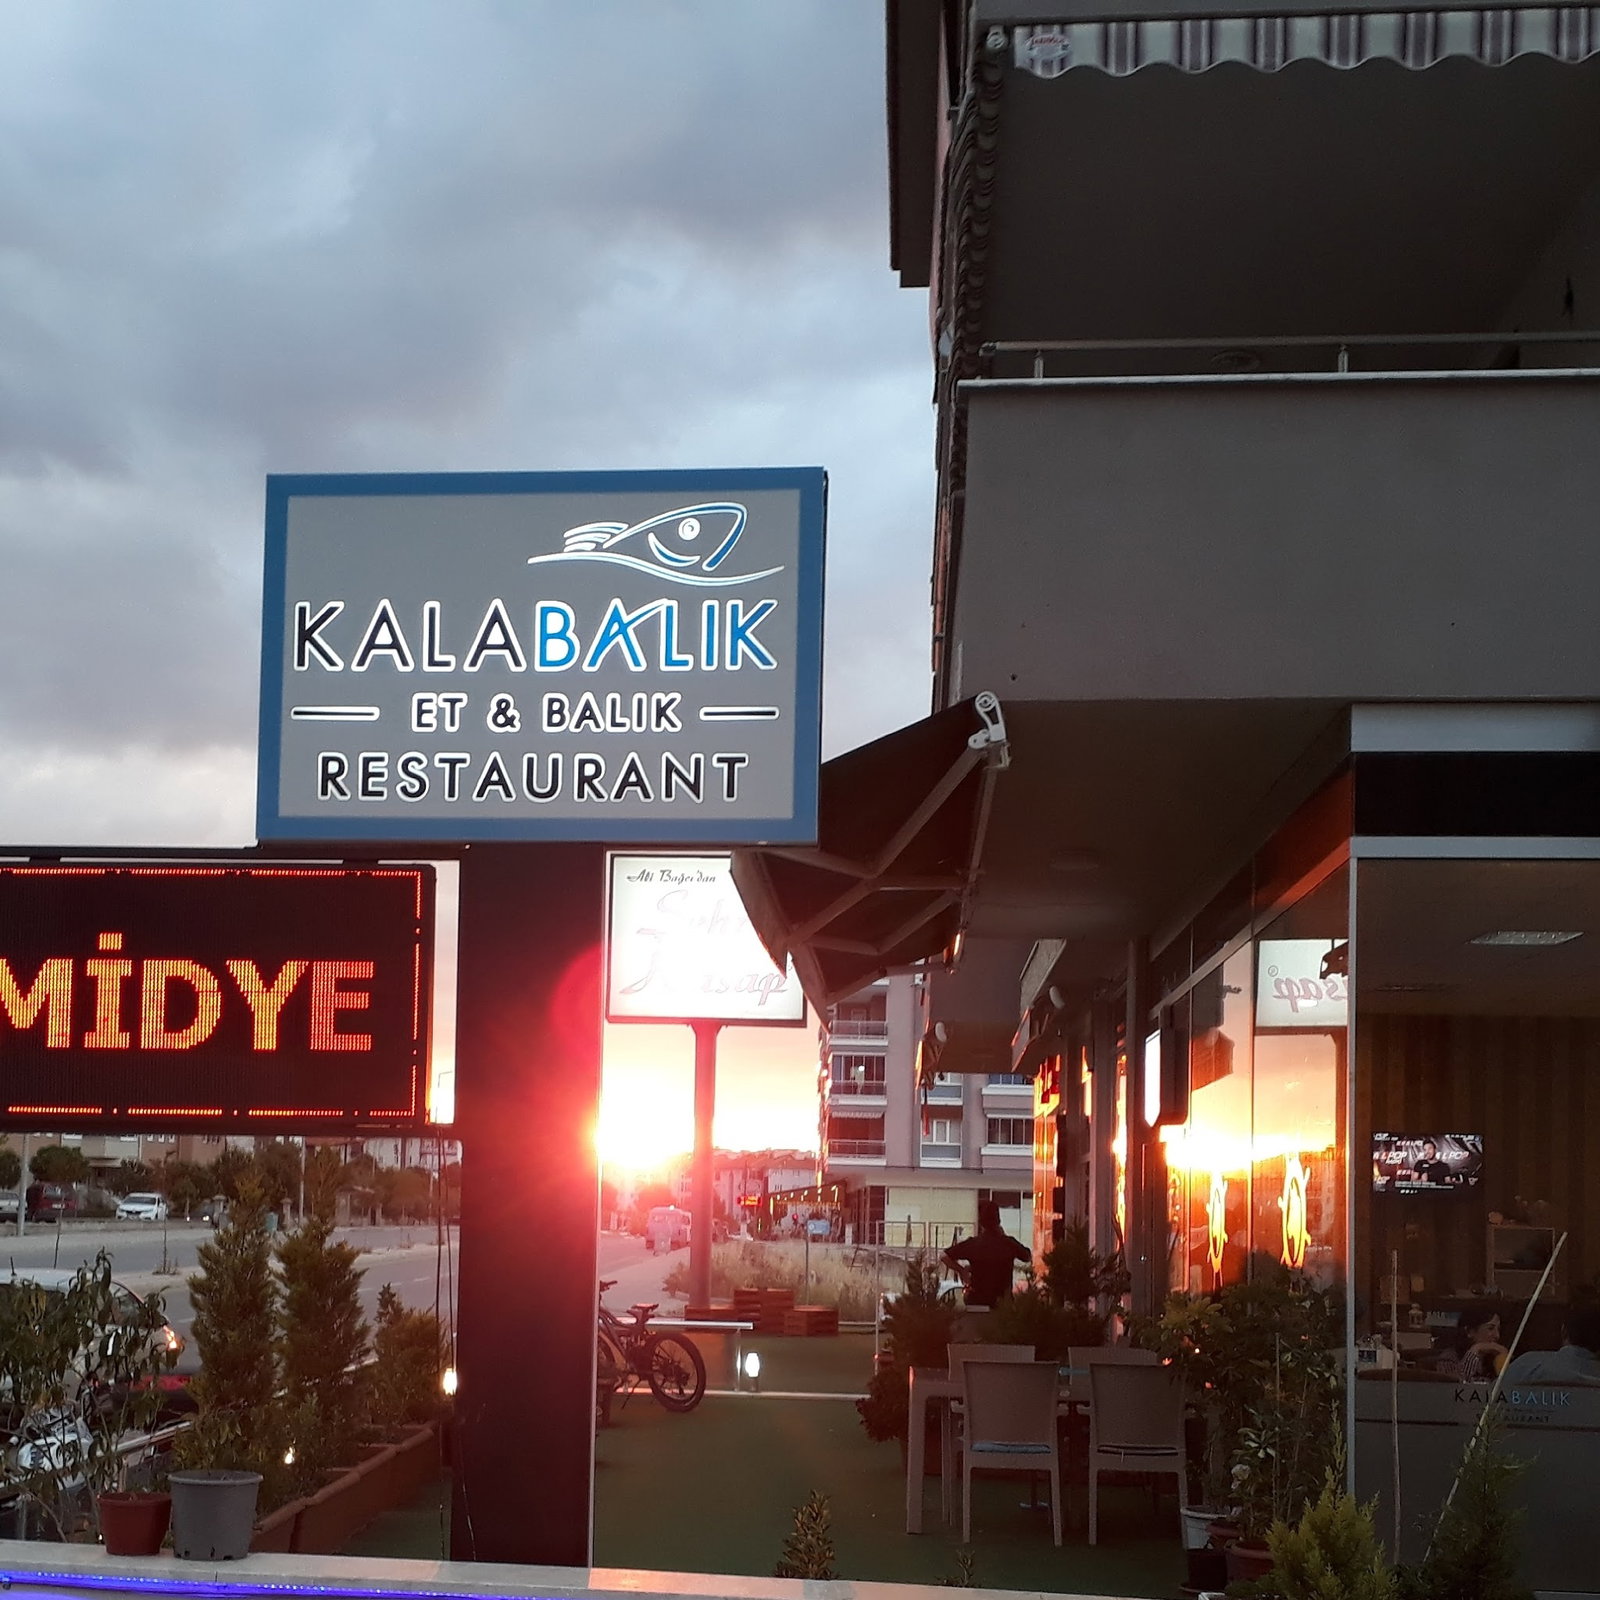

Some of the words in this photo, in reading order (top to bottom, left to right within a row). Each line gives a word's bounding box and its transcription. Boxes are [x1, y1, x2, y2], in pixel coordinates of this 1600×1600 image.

[293, 599, 778, 673] KALABALIK
[412, 692, 467, 732] ET
[487, 693, 521, 732] &
[541, 692, 682, 732] BALIK
[317, 752, 749, 803] RESTAURANT
